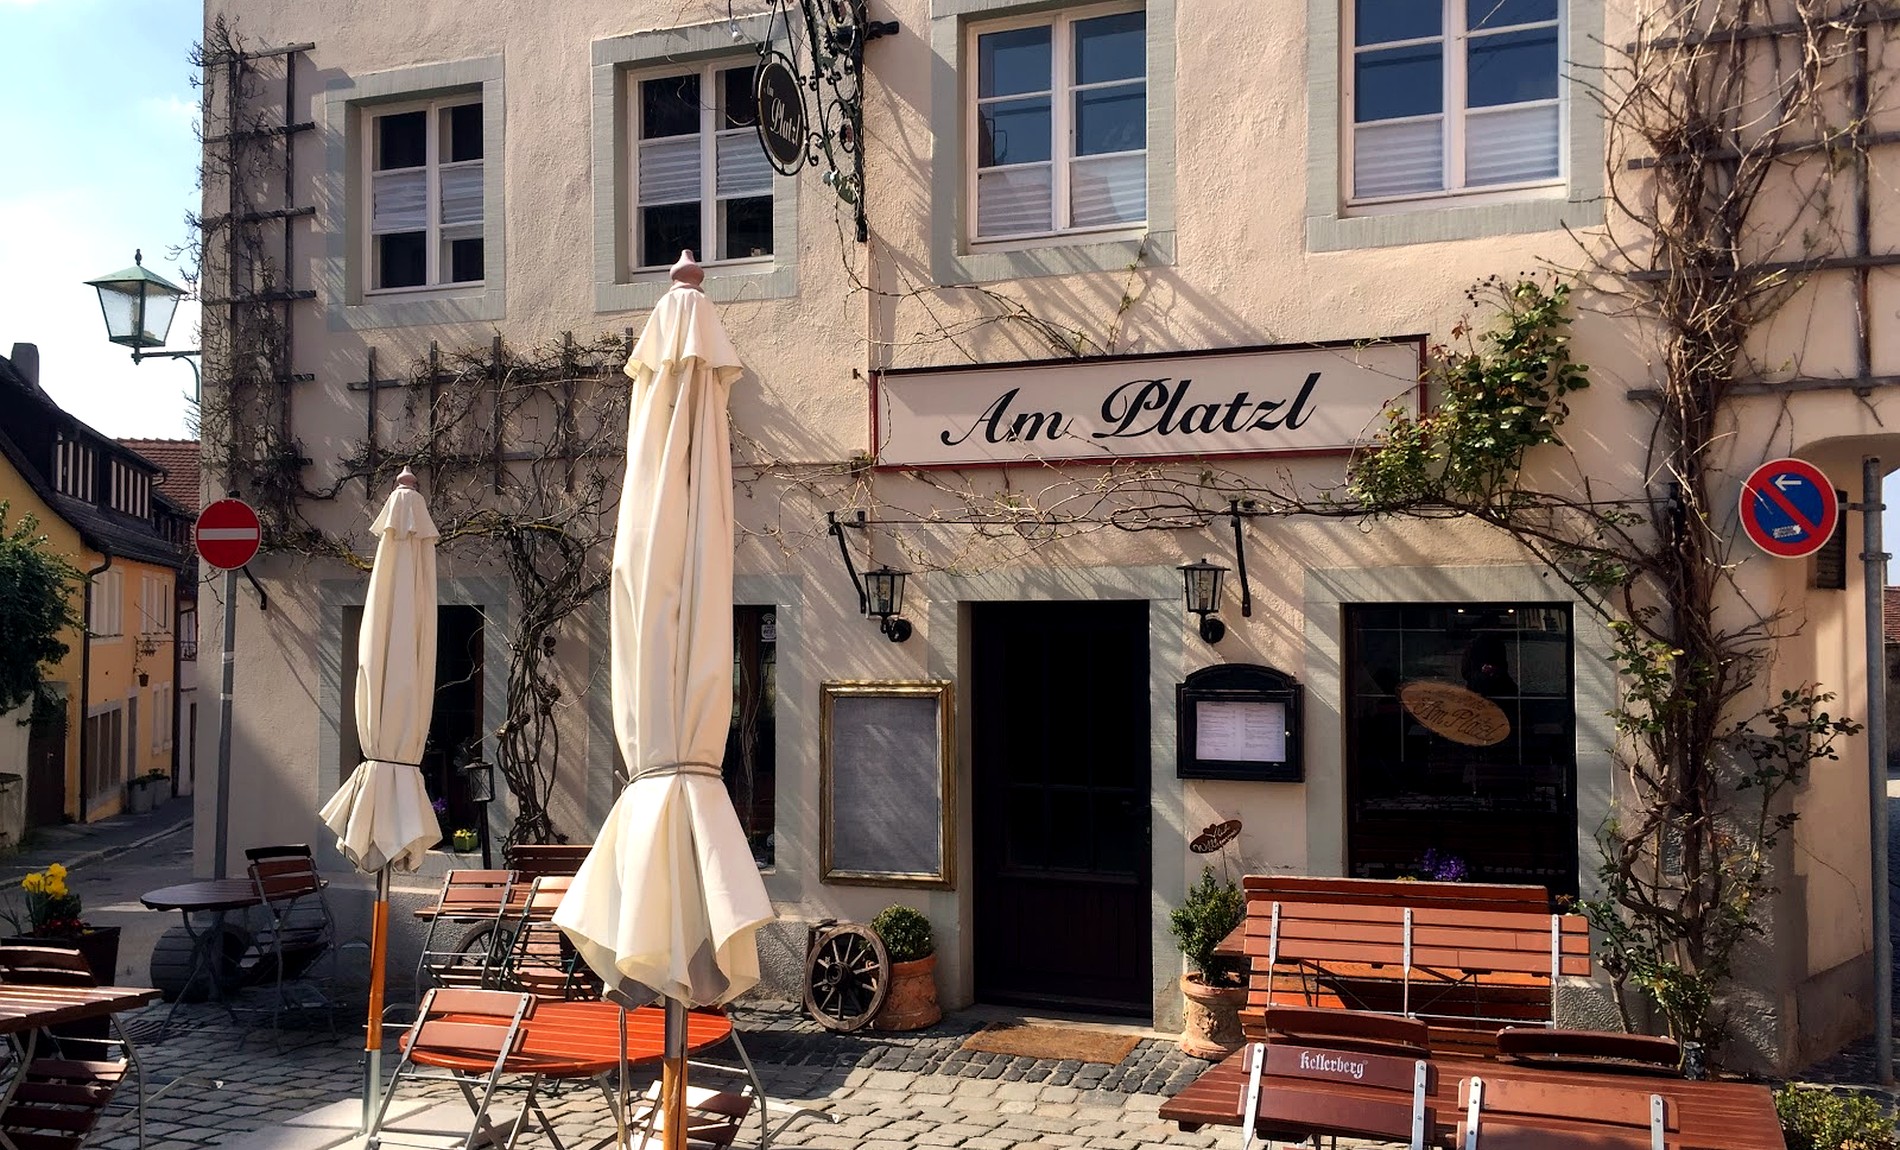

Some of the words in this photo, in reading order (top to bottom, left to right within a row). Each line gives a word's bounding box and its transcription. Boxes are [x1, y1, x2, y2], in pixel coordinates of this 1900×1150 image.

[770, 98, 801, 146] Platzl
[940, 387, 1073, 446] Am
[1091, 371, 1322, 439] Platzl
[1413, 698, 1449, 724] Am
[1445, 708, 1505, 741] Platzl
